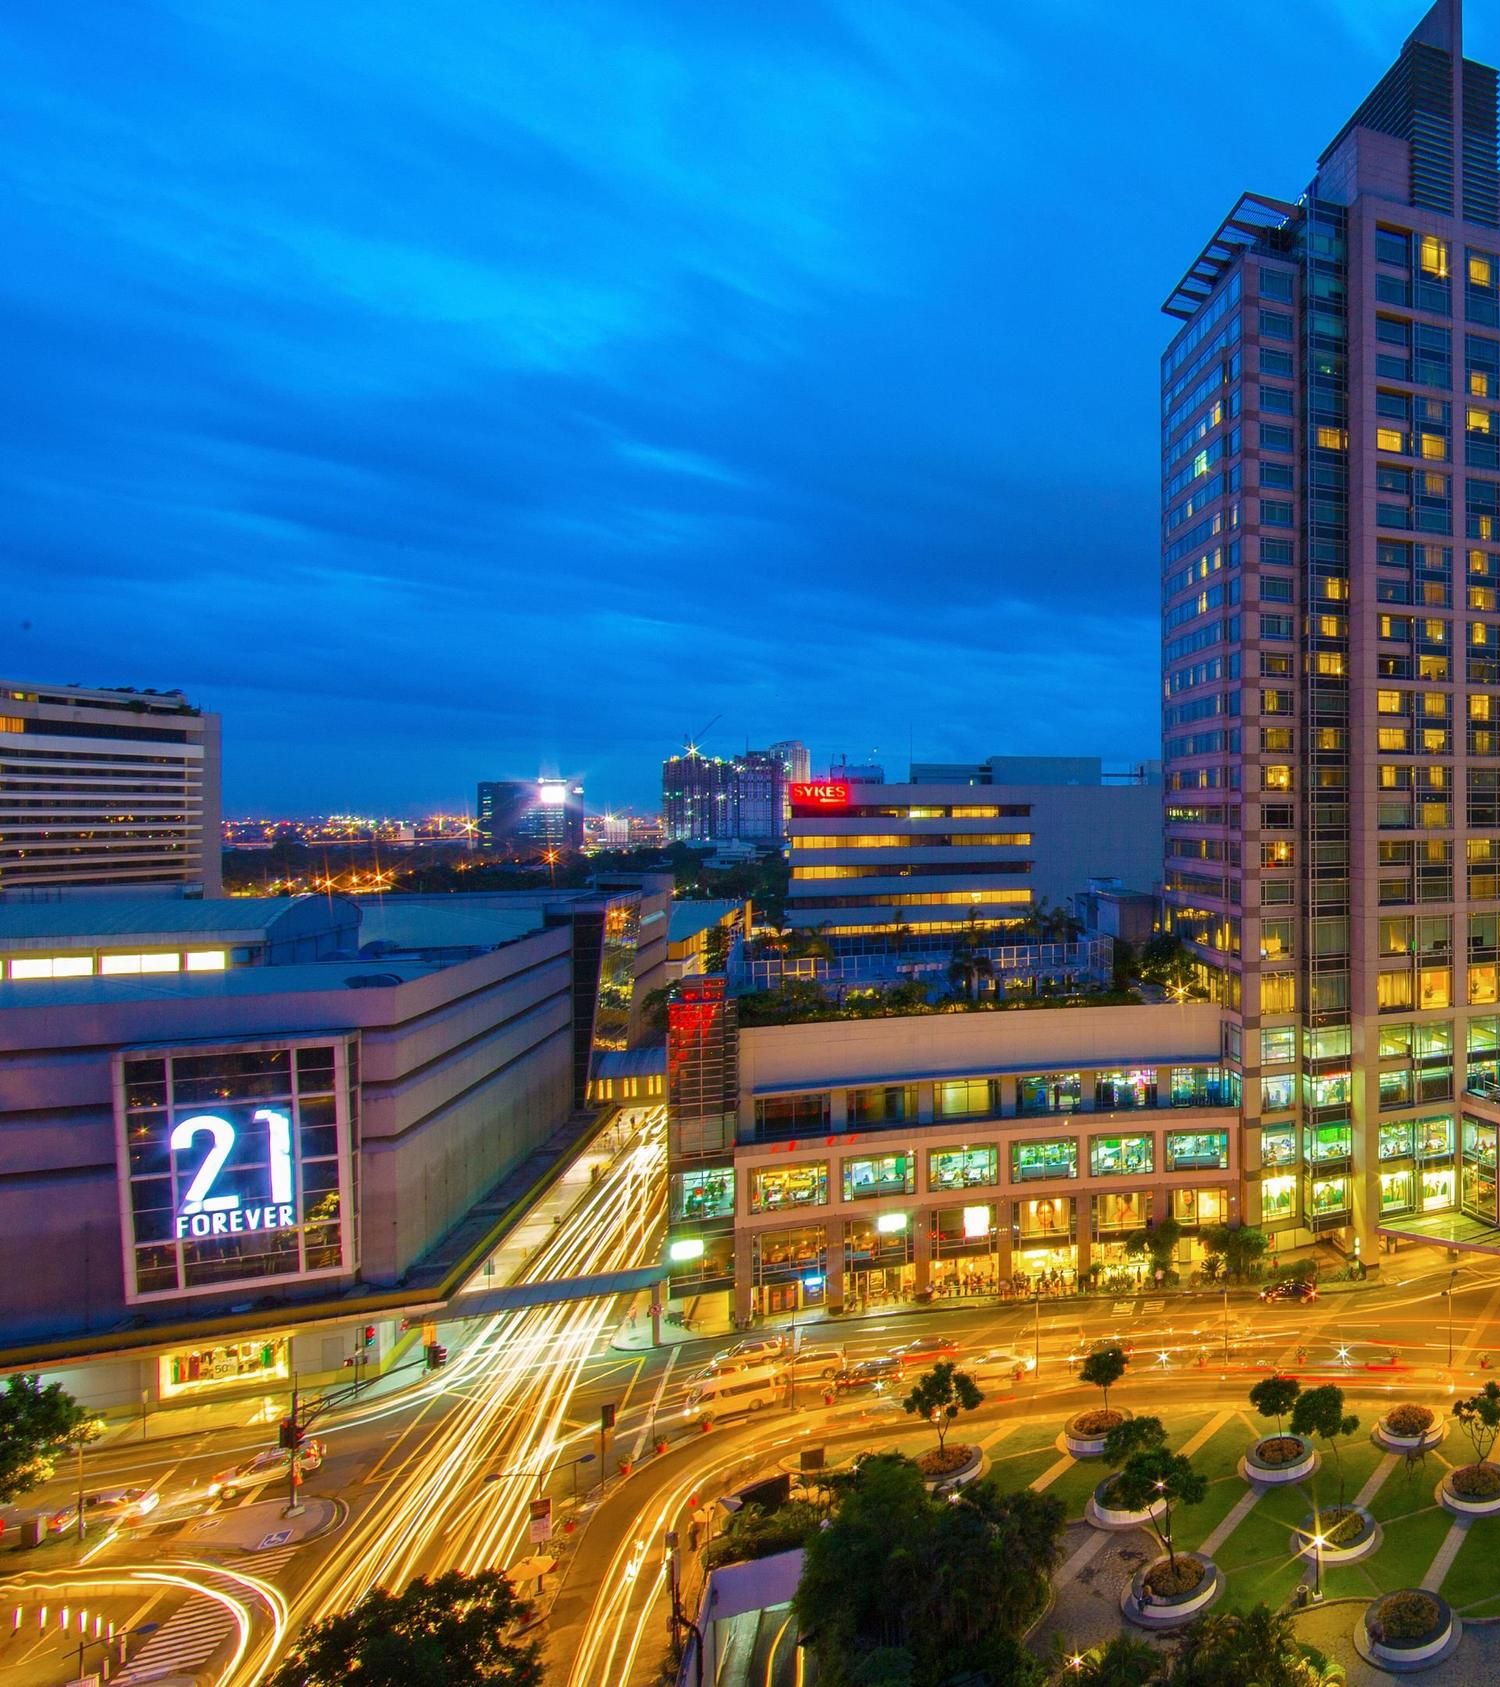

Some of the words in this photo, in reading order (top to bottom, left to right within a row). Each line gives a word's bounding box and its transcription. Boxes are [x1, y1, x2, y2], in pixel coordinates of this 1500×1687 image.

[794, 785, 846, 797] SYKES
[171, 1109, 292, 1214] 21
[176, 1205, 294, 1238] FOREVER
